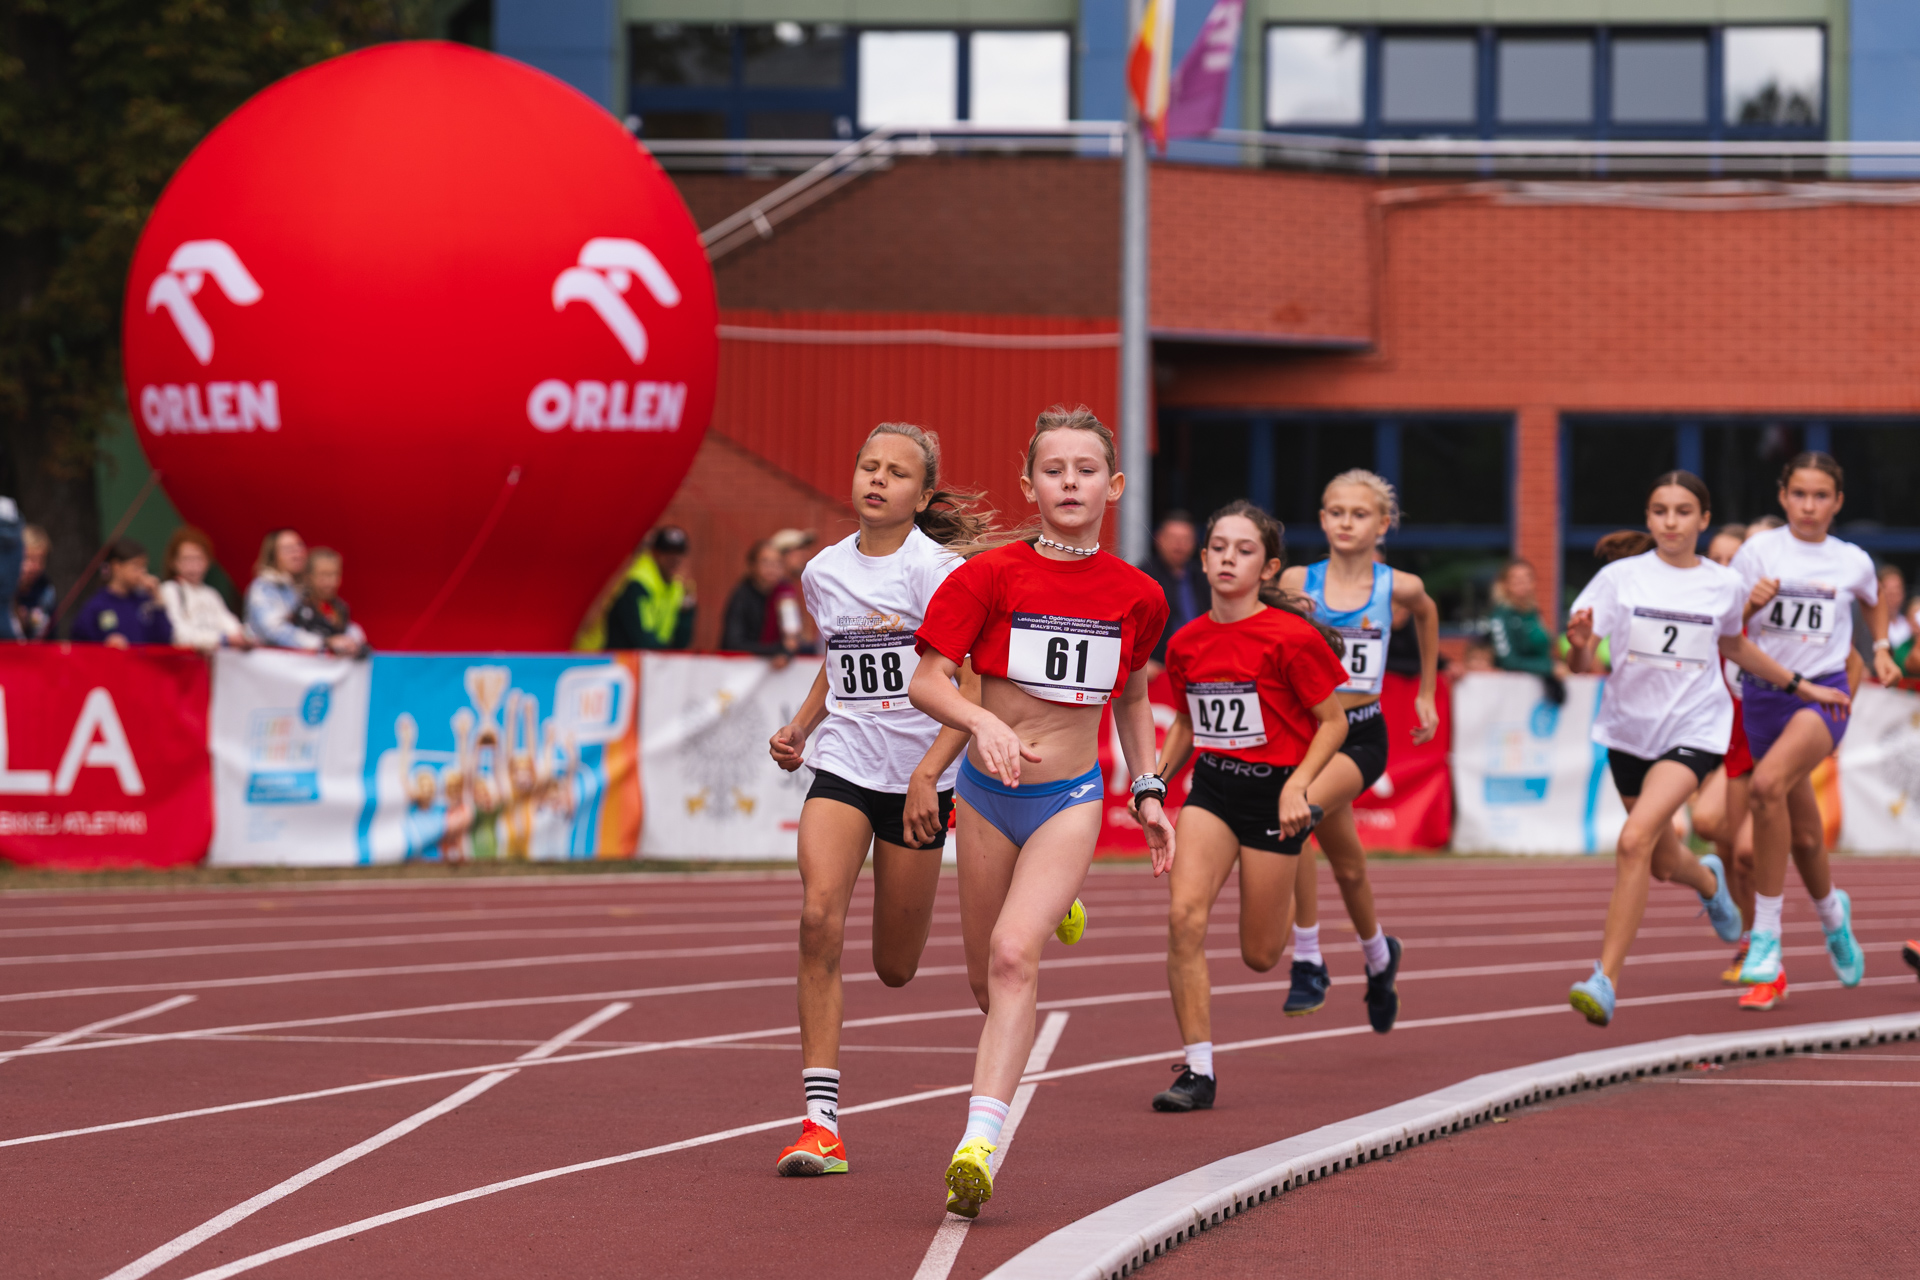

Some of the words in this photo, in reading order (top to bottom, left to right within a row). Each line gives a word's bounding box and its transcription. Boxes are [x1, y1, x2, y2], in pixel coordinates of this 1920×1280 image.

[141, 380, 281, 436] ORLEN
[526, 378, 687, 433] ORLEN
[1770, 601, 1822, 629] 476
[1661, 625, 1678, 654] 2
[840, 652, 904, 694] 368
[1045, 636, 1089, 683] 61
[1351, 643, 1367, 673] 5
[1198, 698, 1249, 732] 422
[1220, 759, 1272, 778] PRO
